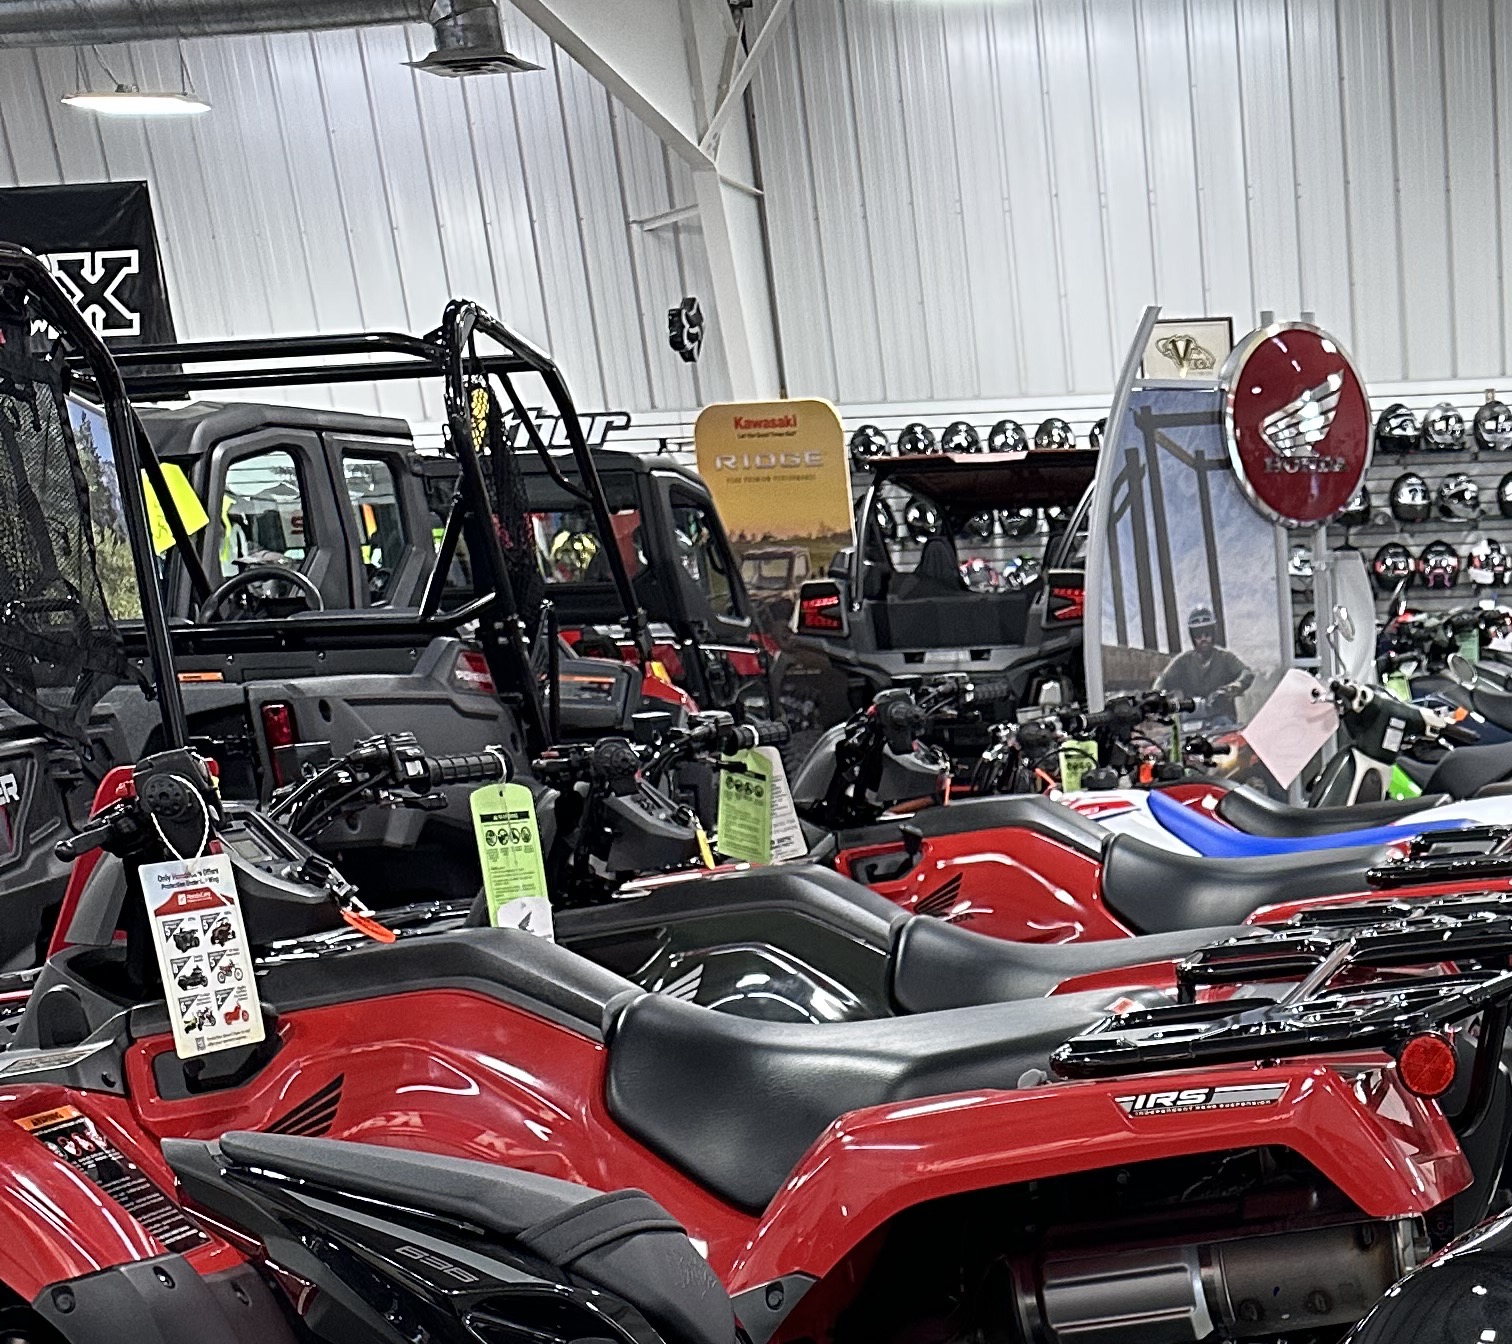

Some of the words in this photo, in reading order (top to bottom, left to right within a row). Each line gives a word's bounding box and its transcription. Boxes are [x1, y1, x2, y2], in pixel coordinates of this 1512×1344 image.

[733, 413, 798, 431] Kawasaki
[714, 450, 824, 472] RIDGE
[1263, 456, 1347, 474] HONDA
[1133, 1087, 1210, 1110] IRS
